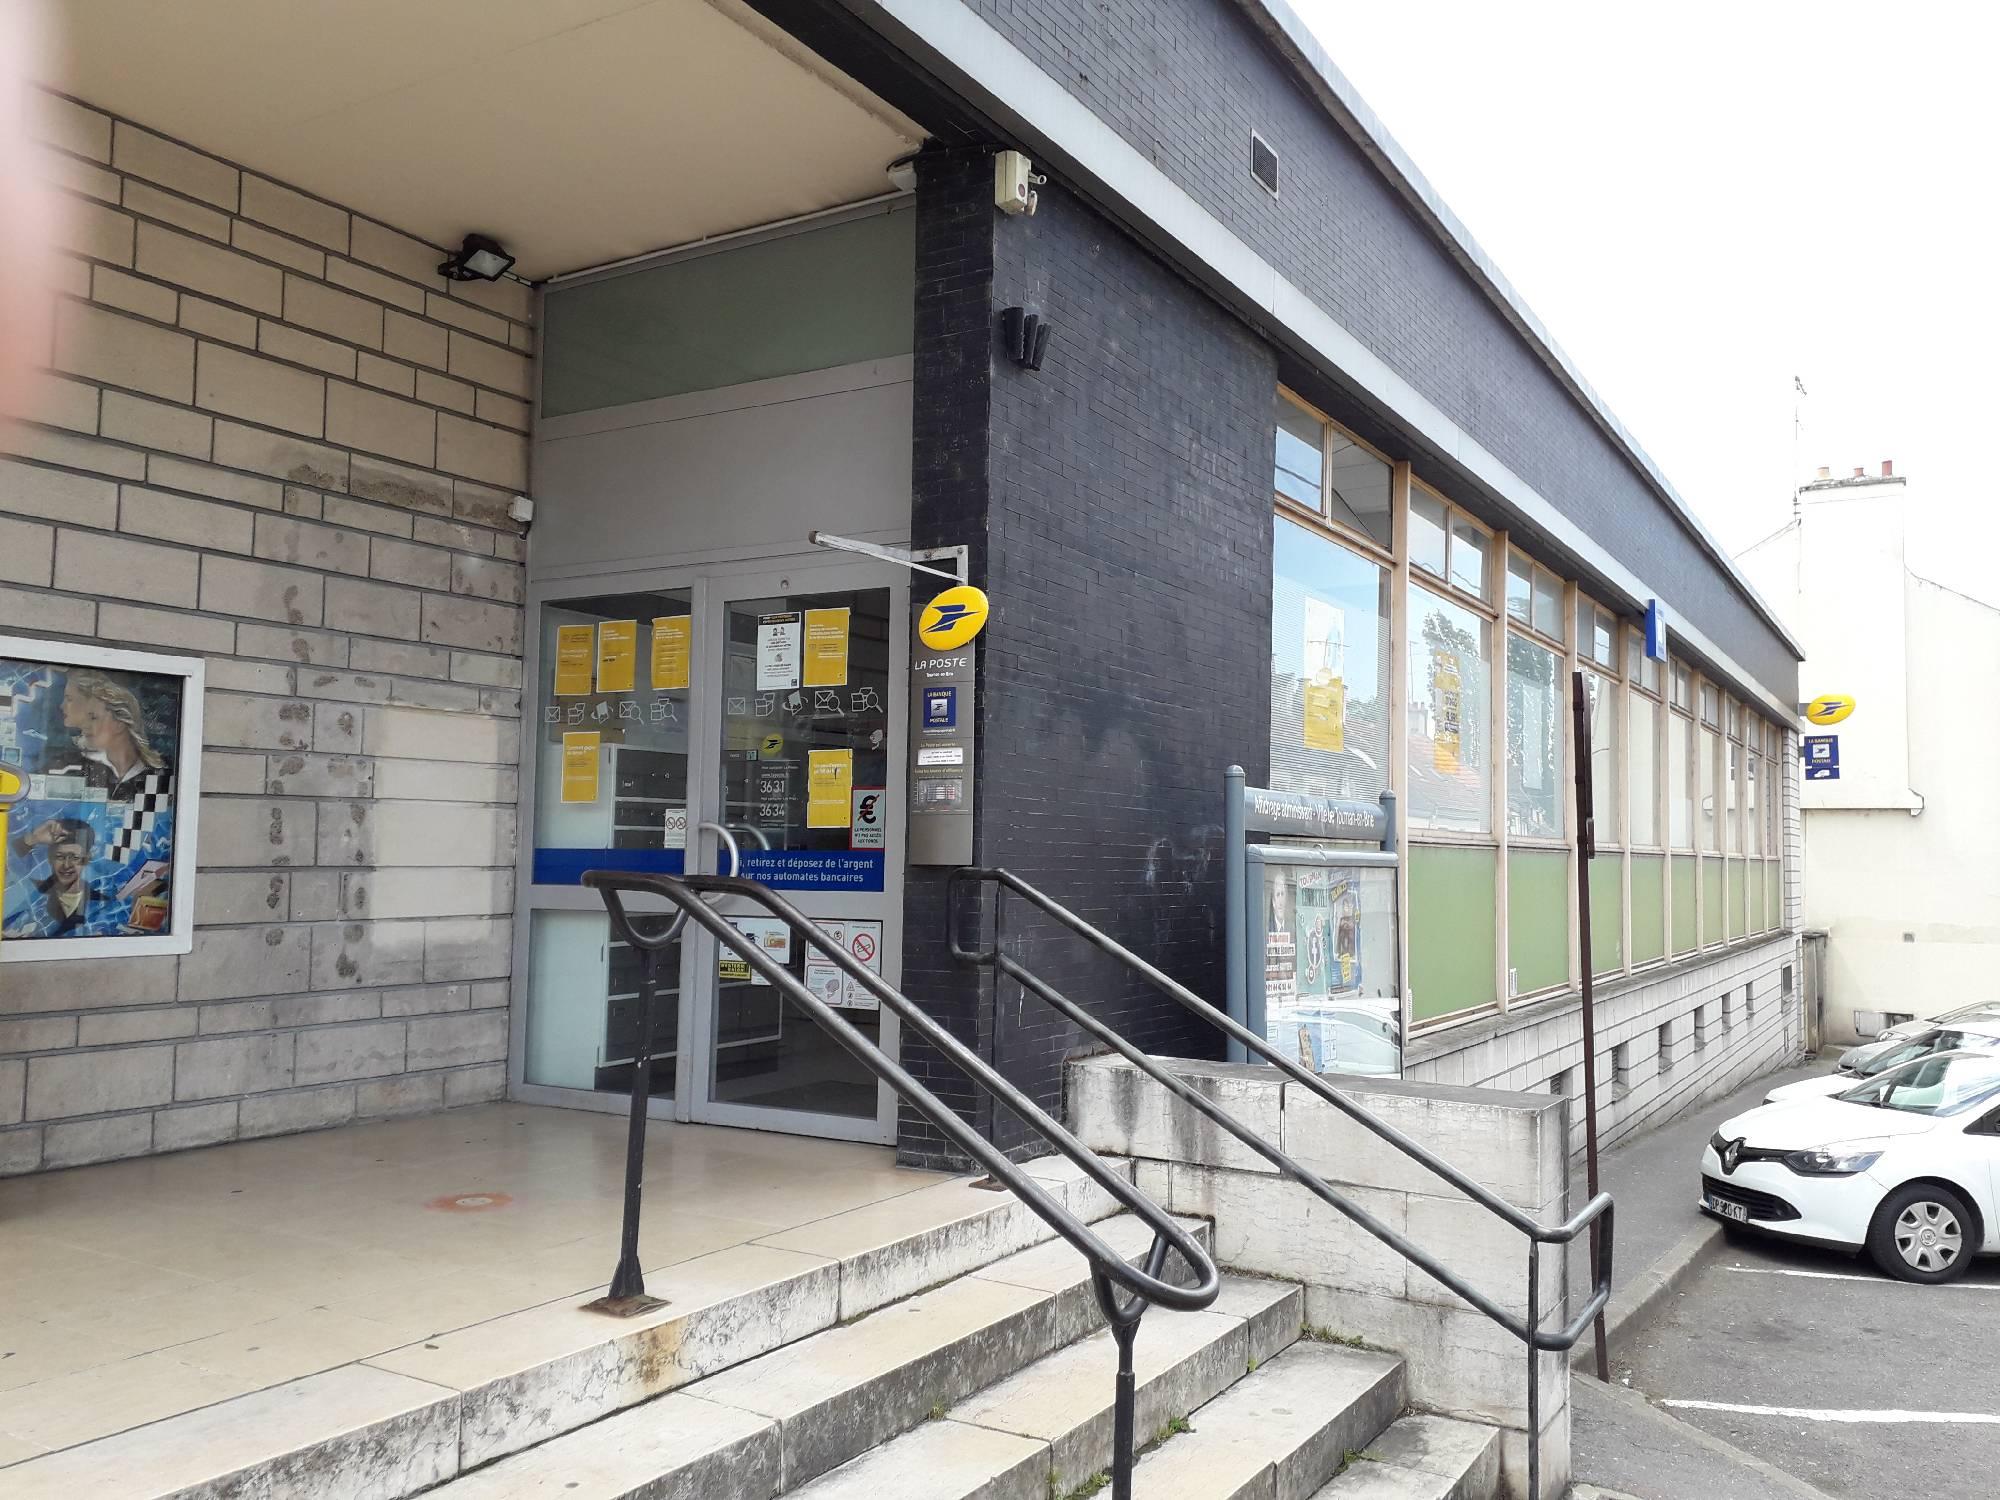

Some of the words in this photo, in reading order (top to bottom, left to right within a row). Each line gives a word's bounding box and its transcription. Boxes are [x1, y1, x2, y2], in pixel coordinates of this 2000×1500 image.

[915, 660, 927, 670] LA
[929, 657, 968, 669] POSTE
[747, 858, 775, 868] retirez
[777, 859, 786, 868] et
[788, 857, 823, 870] déposez
[825, 859, 836, 869] de
[838, 858, 874, 871] l'argent
[756, 873, 771, 881] nos
[773, 872, 819, 882] automates
[821, 872, 864, 882] bancaires
